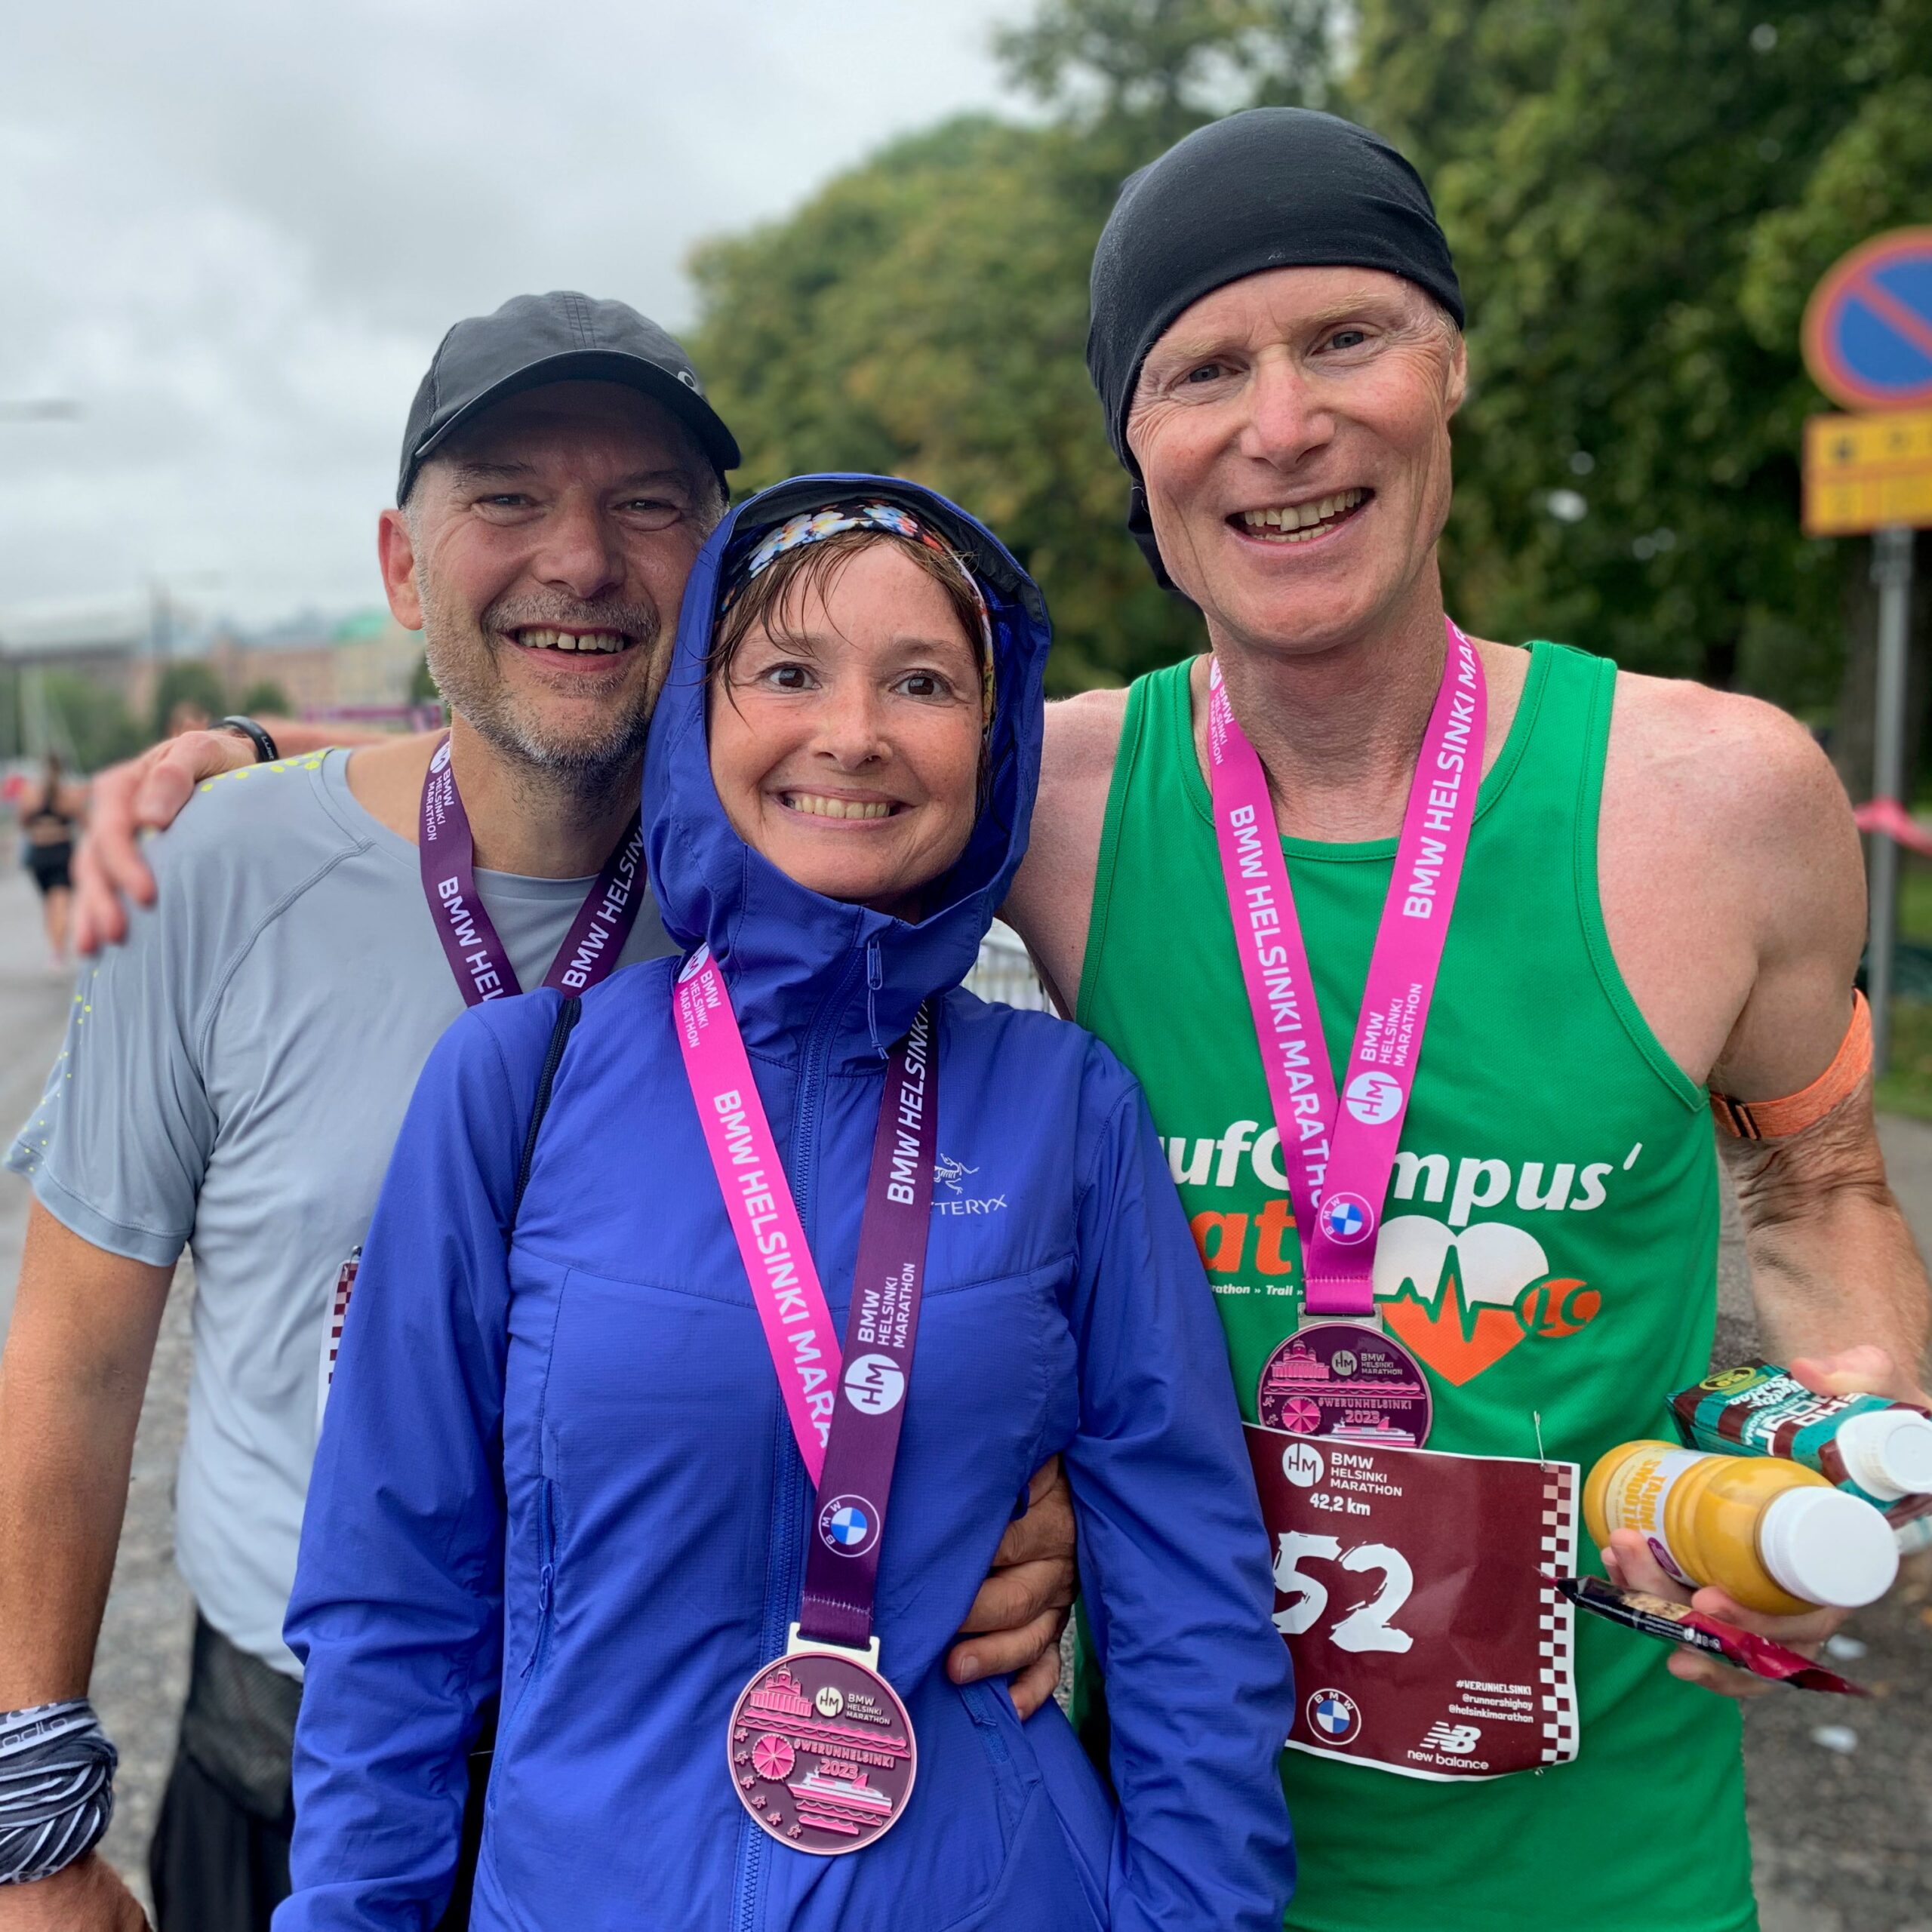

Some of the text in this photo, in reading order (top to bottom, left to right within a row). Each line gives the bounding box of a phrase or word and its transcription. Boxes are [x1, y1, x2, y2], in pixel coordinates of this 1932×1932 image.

[1423, 691, 1475, 832] HELSINKI
[435, 774, 447, 825] HELSINKI
[442, 767, 455, 807] BMW
[425, 780, 438, 841] MARATHON
[1229, 804, 1269, 879] BMW
[1403, 835, 1447, 919] BMW
[437, 876, 482, 947] BMW
[561, 922, 610, 989] BMW
[1245, 884, 1303, 1034] HELSINKI
[689, 978, 709, 1029] HELSINKI
[700, 968, 721, 1009] BMW
[678, 987, 700, 1049] MARATHON
[1360, 1011, 1386, 1063] BMW
[1377, 997, 1404, 1065] HELSINKI
[1392, 982, 1423, 1067] MARATHON
[886, 1129, 921, 1206] BMW
[713, 1089, 760, 1165] BMW
[737, 1169, 811, 1325] HELSINKI
[877, 1277, 899, 1346] HELSINKI
[893, 1263, 916, 1349] MARATHON
[1266, 1285, 1294, 1296] Trail
[858, 1290, 881, 1343] BMW
[1361, 1353, 1386, 1362] BMW
[1318, 1398, 1413, 1411] #WERUNHELSINKI
[1345, 1410, 1380, 1424] 2023
[1331, 1452, 1374, 1469] BMW
[1331, 1467, 1388, 1483] HELSINKI
[1309, 1493, 1371, 1516] 42,2 km
[1330, 1480, 1403, 1497] MARATHON
[822, 1501, 841, 1545] BMW
[848, 1693, 875, 1707] BMW
[1314, 1691, 1355, 1712] BMW
[1456, 1679, 1532, 1696] #WERUNHELSINKI
[846, 1710, 891, 1726] MARATHON
[847, 1703, 882, 1716] HELSINKI
[1448, 1703, 1534, 1723] @helsinkimarathon
[793, 1737, 896, 1769] #WERUNHELSINKI
[819, 1758, 859, 1779] 2023
[1407, 1749, 1490, 1770] new balance
